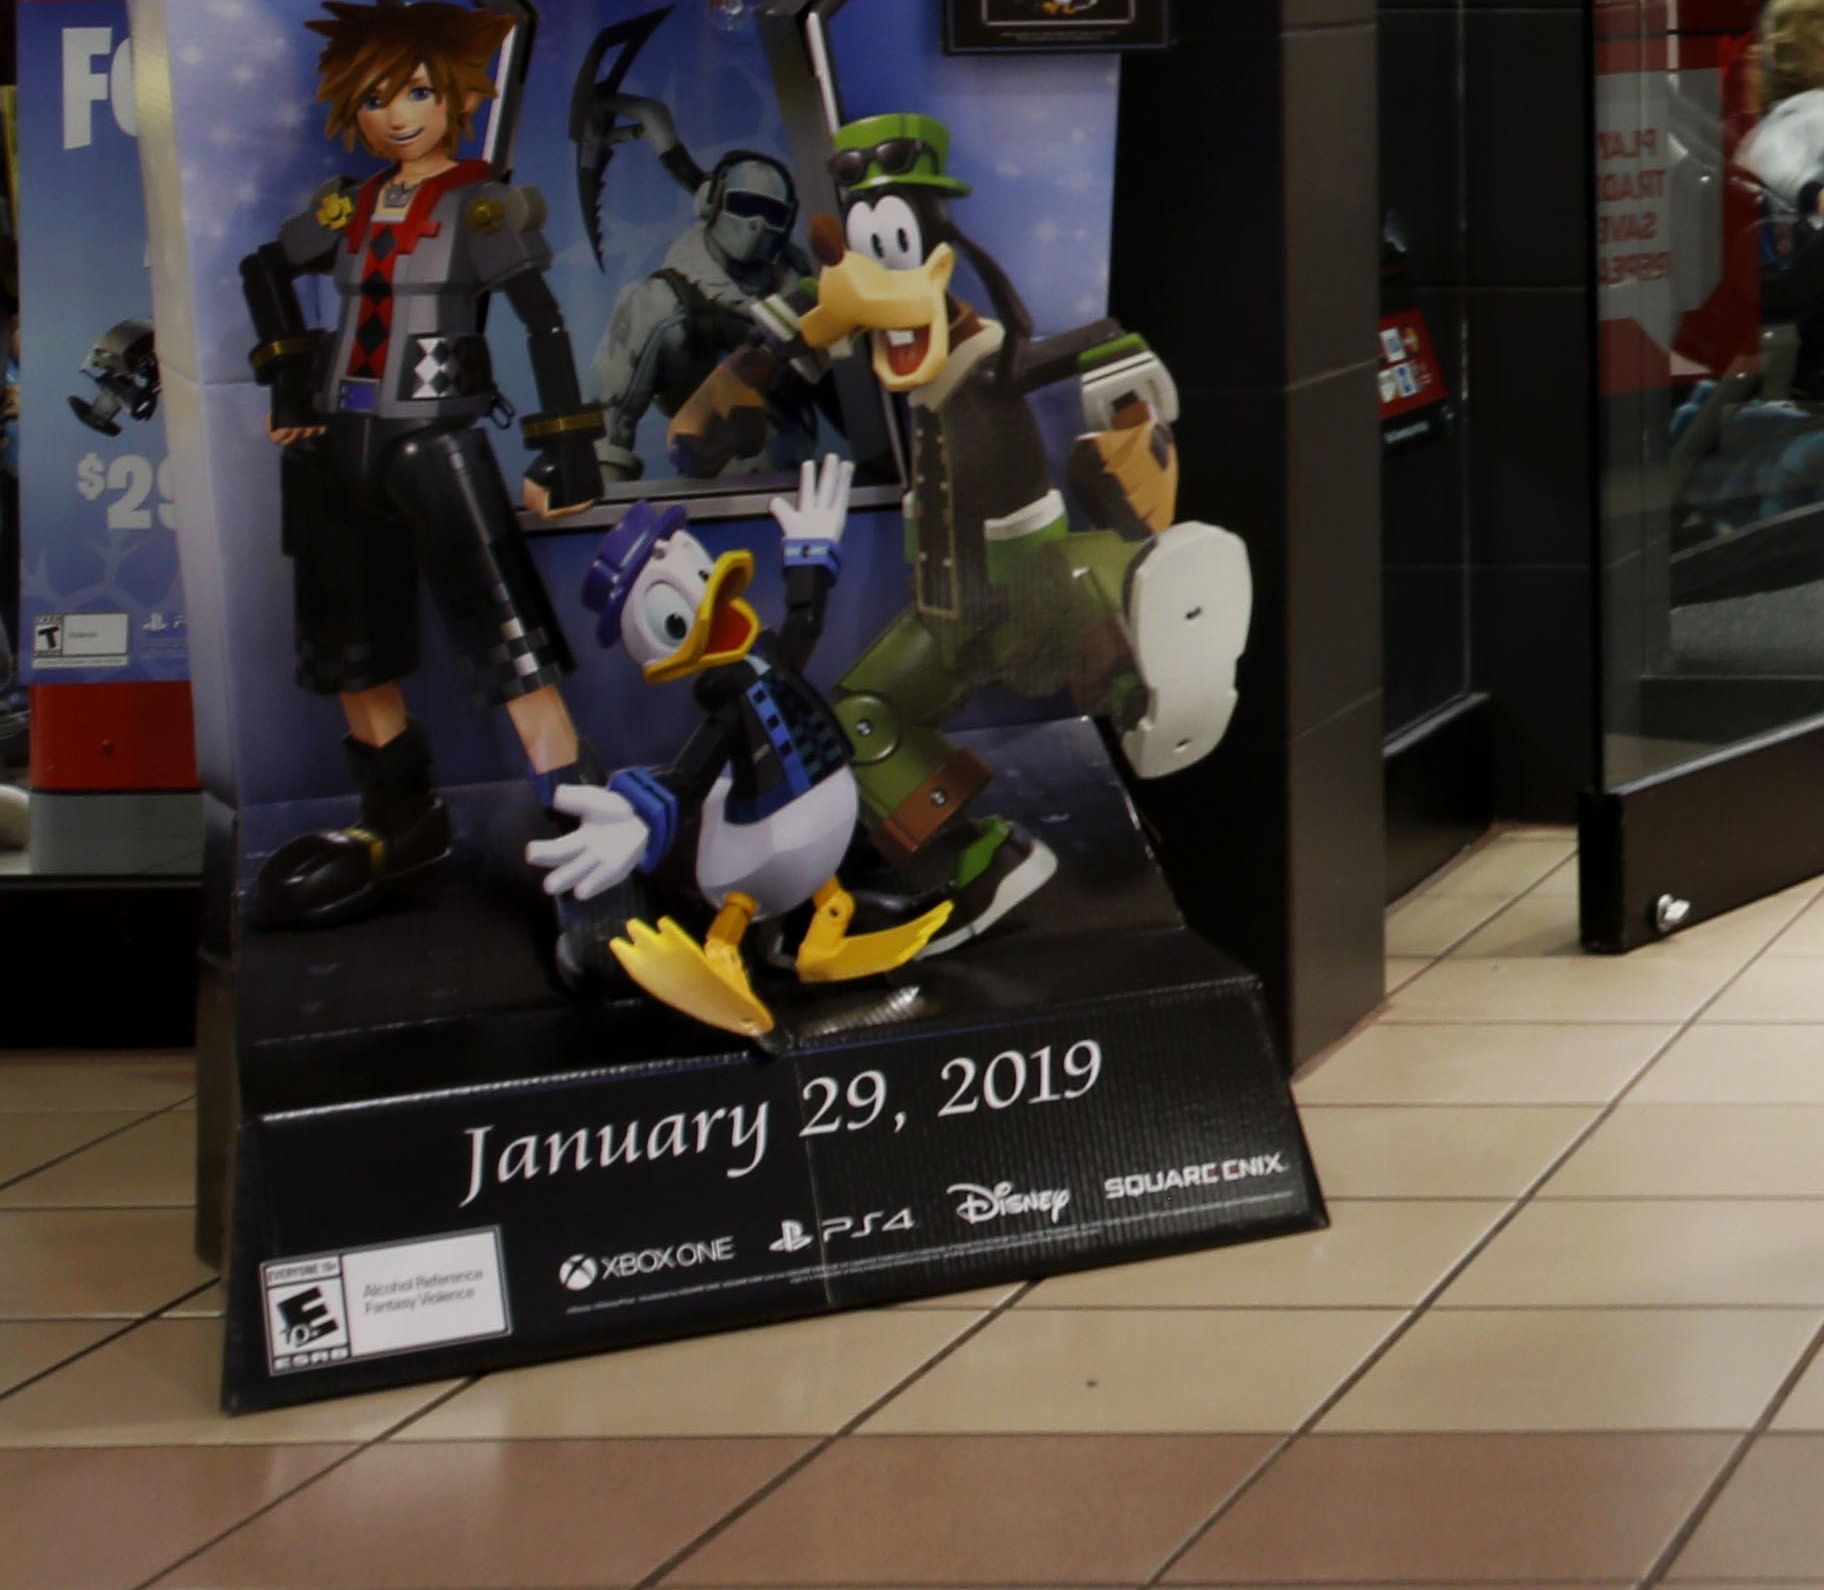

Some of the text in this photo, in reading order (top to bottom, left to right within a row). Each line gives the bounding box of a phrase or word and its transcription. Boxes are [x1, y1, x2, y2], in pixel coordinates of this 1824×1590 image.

[457, 1038, 1104, 1207] January 29, 2019
[1104, 1152, 1286, 1201] SQUARE ENIX
[946, 1179, 1071, 1225] Disney
[822, 1207, 917, 1244] PS4
[600, 1235, 737, 1281] XBOX ONE
[363, 1267, 485, 1300] Alcohol Reference
[363, 1287, 476, 1317] Fantasy Violence
